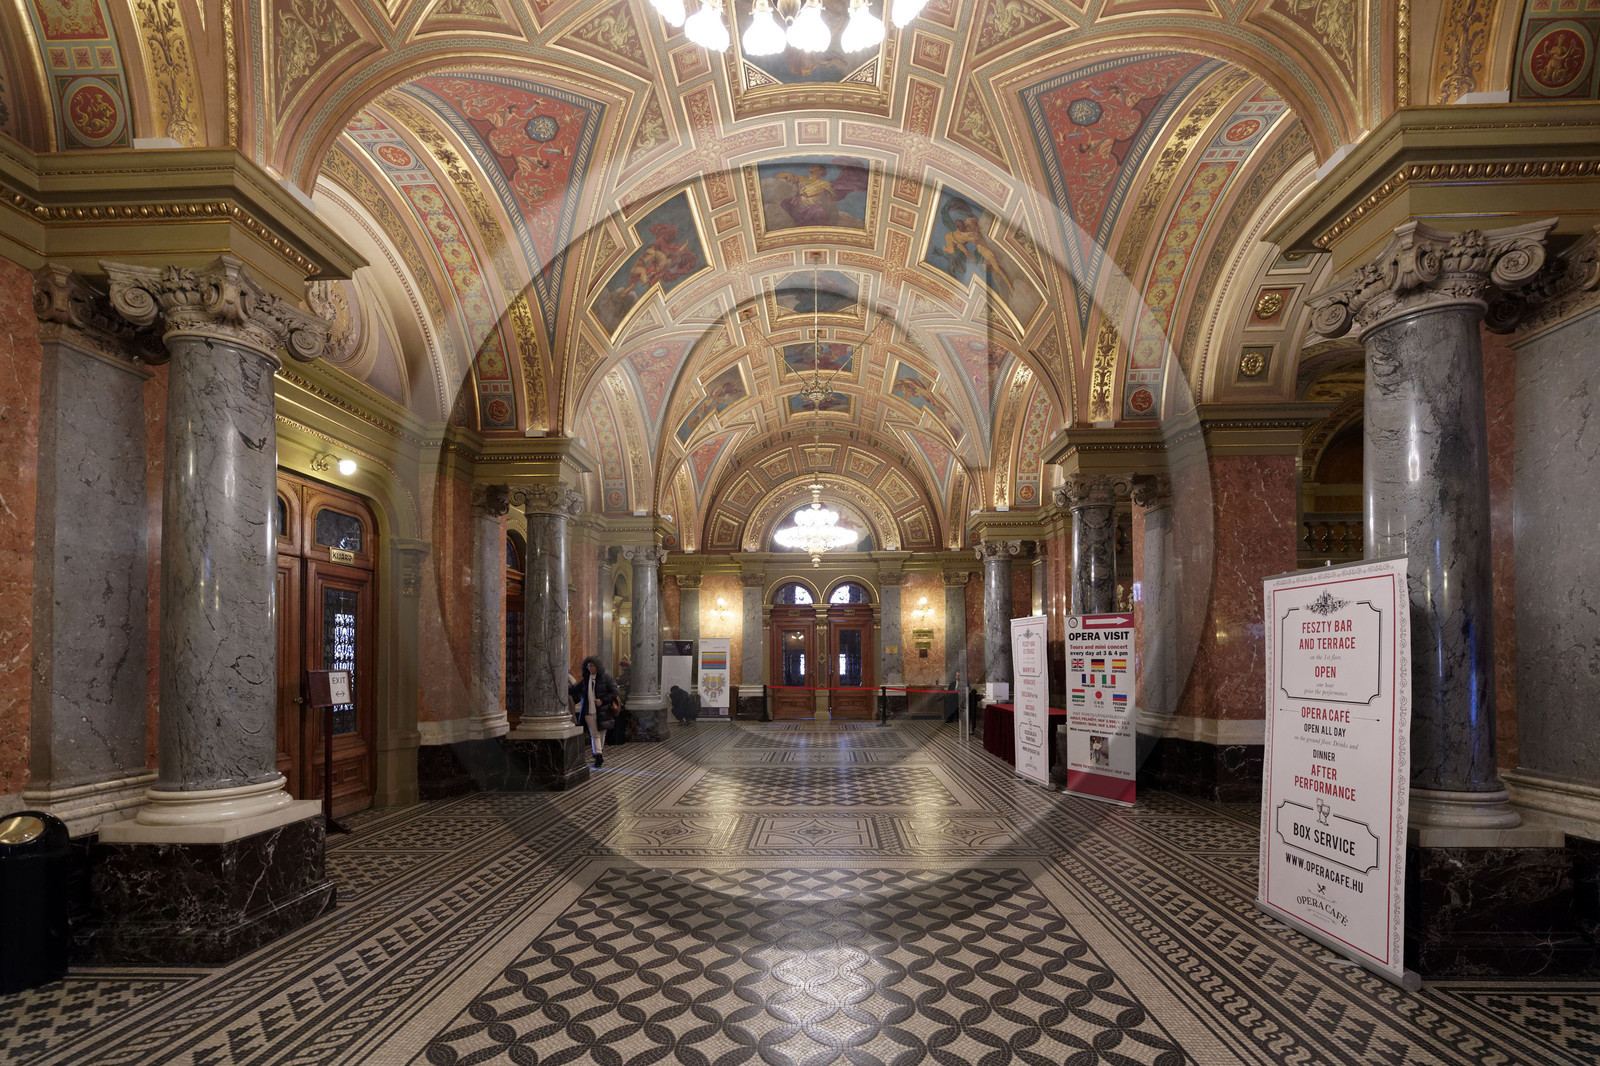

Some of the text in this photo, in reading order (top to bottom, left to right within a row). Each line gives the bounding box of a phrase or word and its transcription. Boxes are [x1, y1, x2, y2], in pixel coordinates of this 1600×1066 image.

[1302, 620, 1352, 634] FESZTY BAR
[1068, 631, 1130, 640] OPERA VISIT
[1299, 636, 1356, 650] AND TERRACE
[1315, 666, 1336, 678] OPEN
[1304, 723, 1346, 737] OPEN ALL DAY
[1312, 749, 1336, 761] DINNER
[1311, 764, 1337, 780] AFTER
[1294, 775, 1356, 802] PERFORMANCE
[1293, 822, 1355, 856] BOX SERVICE
[1285, 852, 1364, 894] WWW.OPERACAFE.HU
